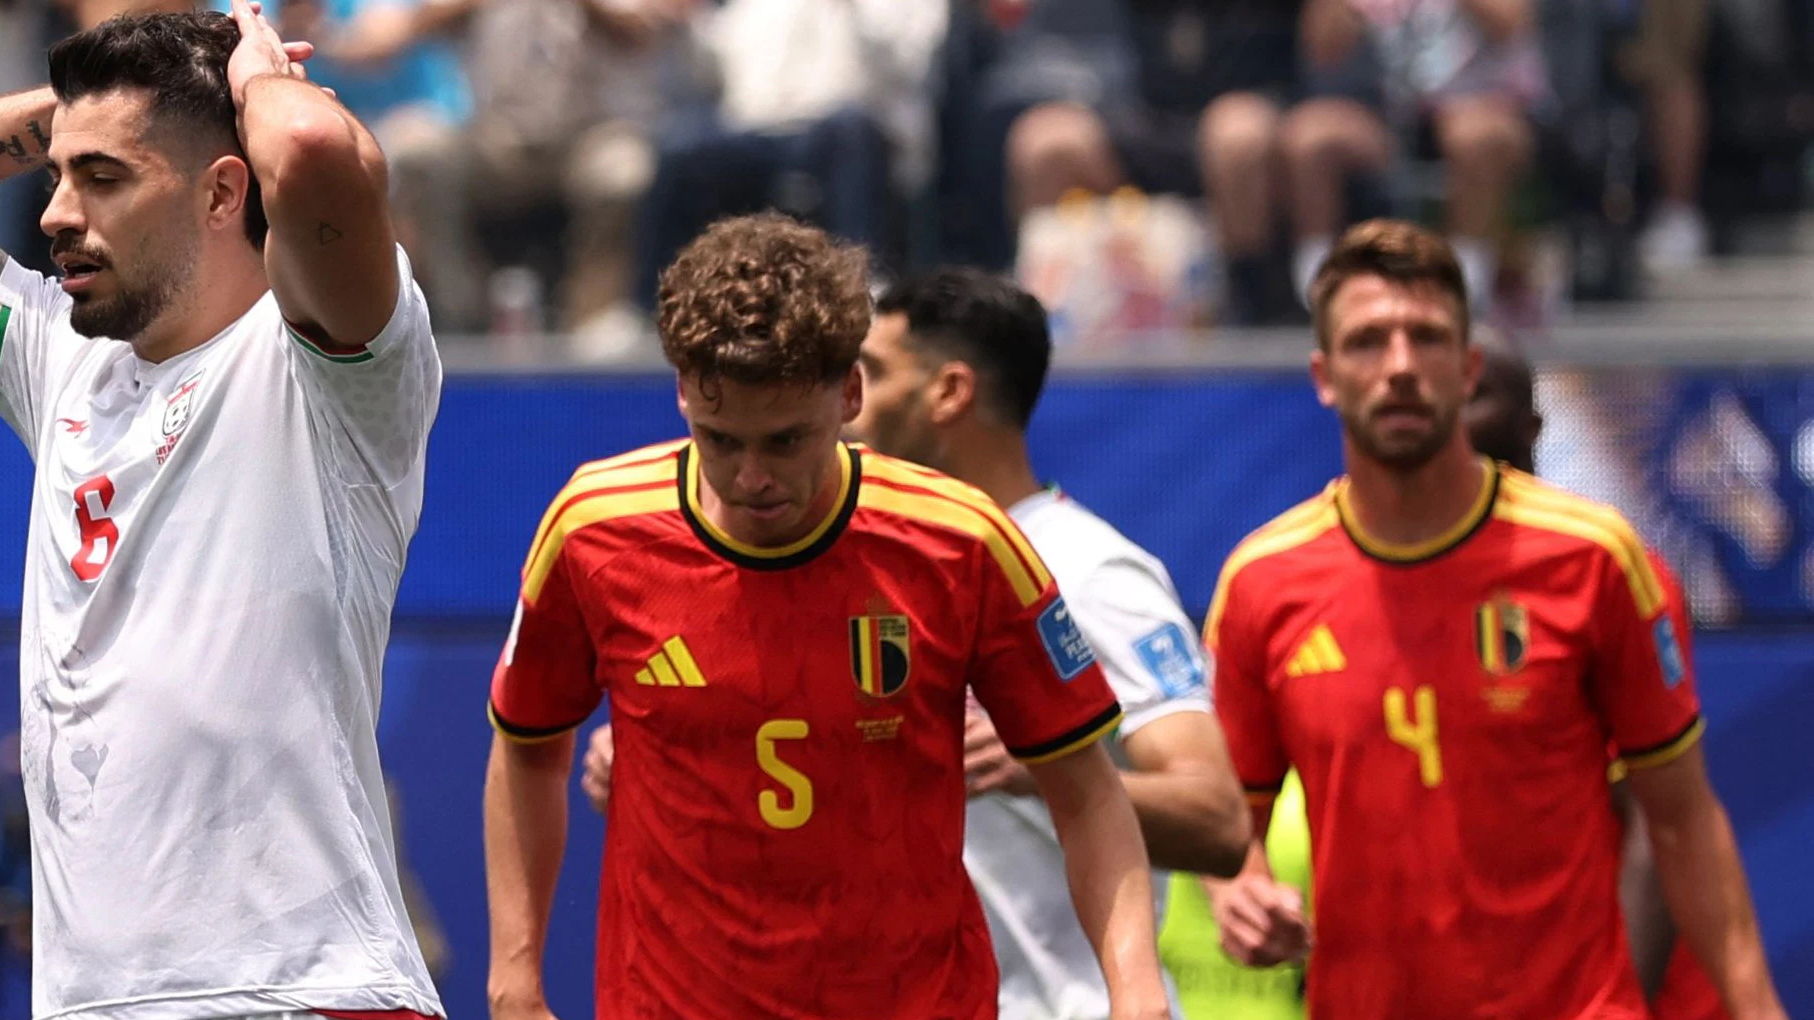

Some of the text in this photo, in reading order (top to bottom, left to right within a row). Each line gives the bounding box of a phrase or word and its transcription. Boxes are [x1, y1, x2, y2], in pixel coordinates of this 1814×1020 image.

[70, 474, 120, 583] 6
[756, 719, 814, 830] 5
[1384, 686, 1443, 789] 4
